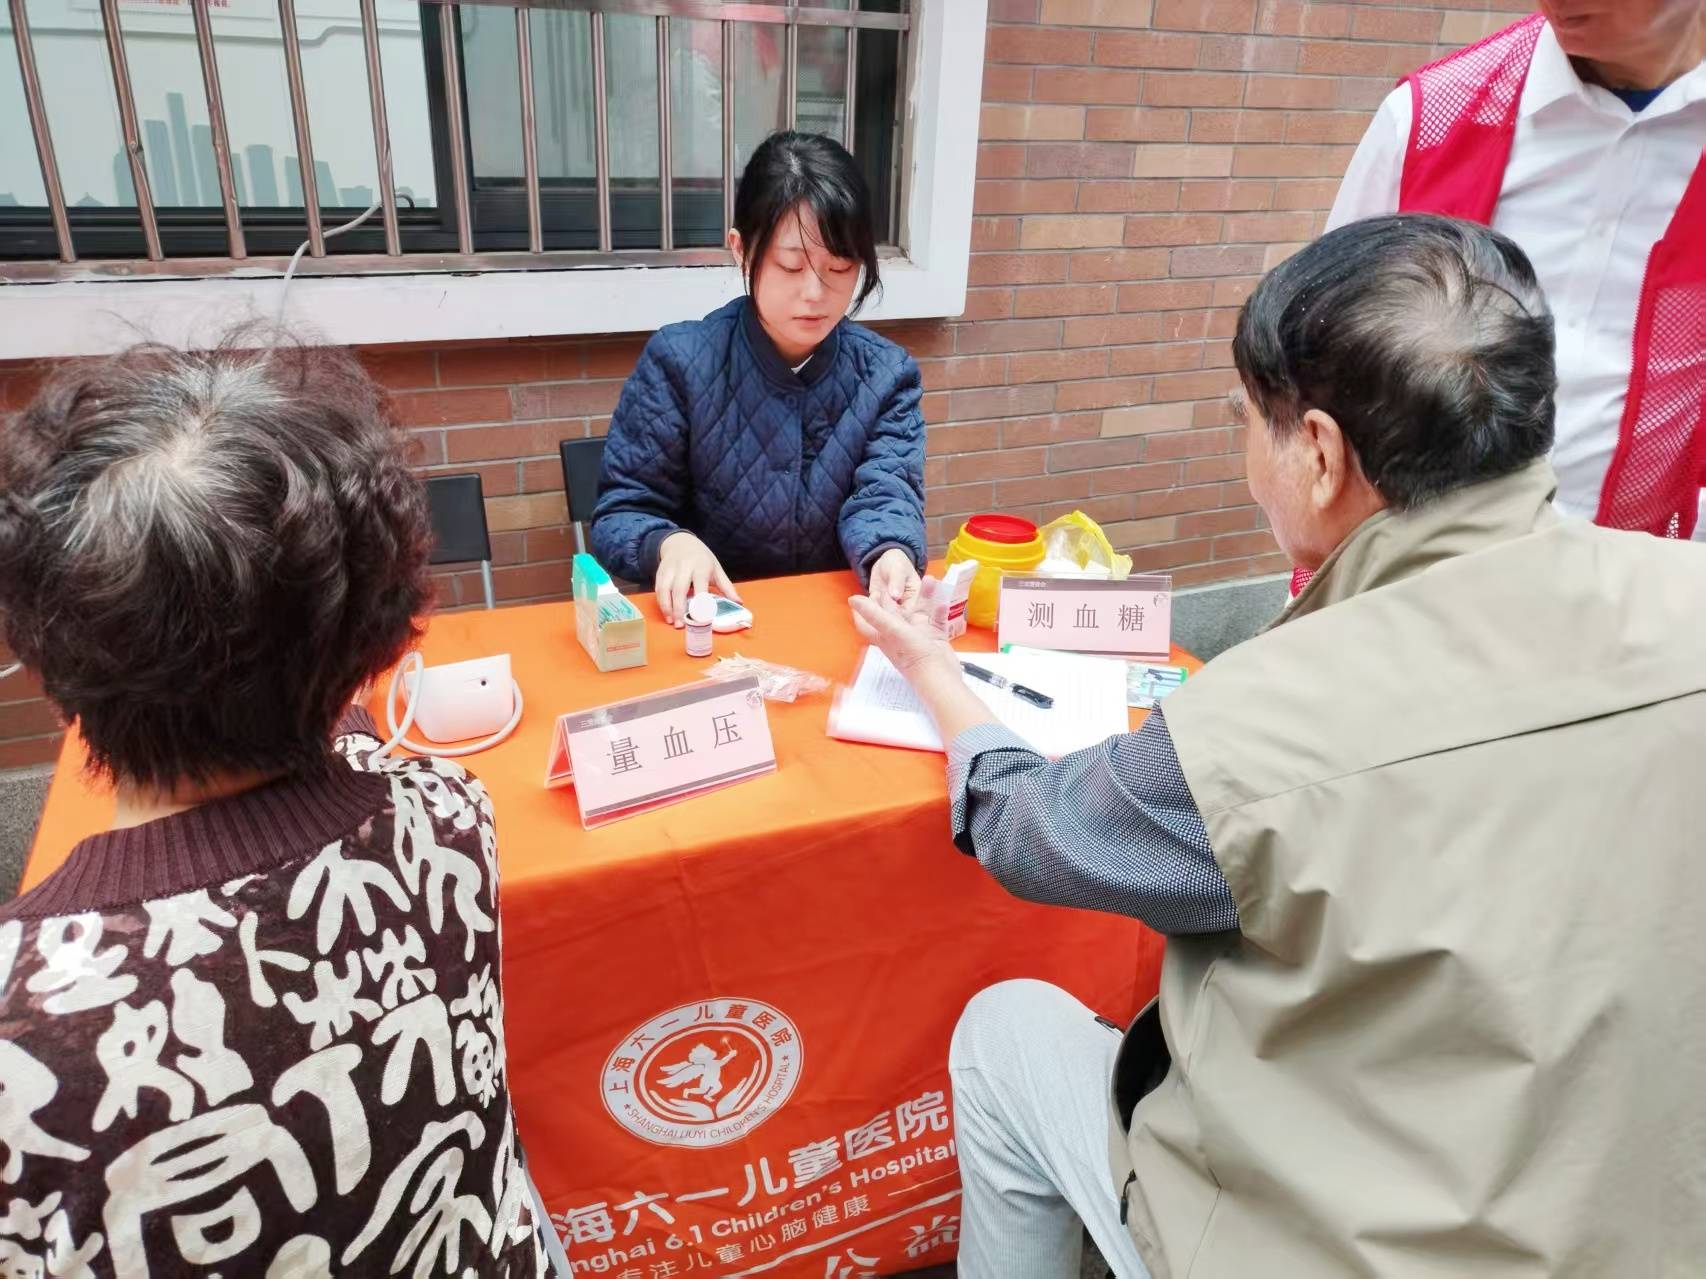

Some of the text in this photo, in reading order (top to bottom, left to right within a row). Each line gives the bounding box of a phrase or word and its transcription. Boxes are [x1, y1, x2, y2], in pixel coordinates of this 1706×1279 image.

[1027, 601, 1145, 632] 测血糖
[606, 711, 743, 776] 量血压
[609, 1004, 793, 1094] 上海六一儿童医院
[766, 1062, 790, 1106] HOSPITAL
[711, 1181, 842, 1237] Children's
[850, 1139, 957, 1188] Hospital
